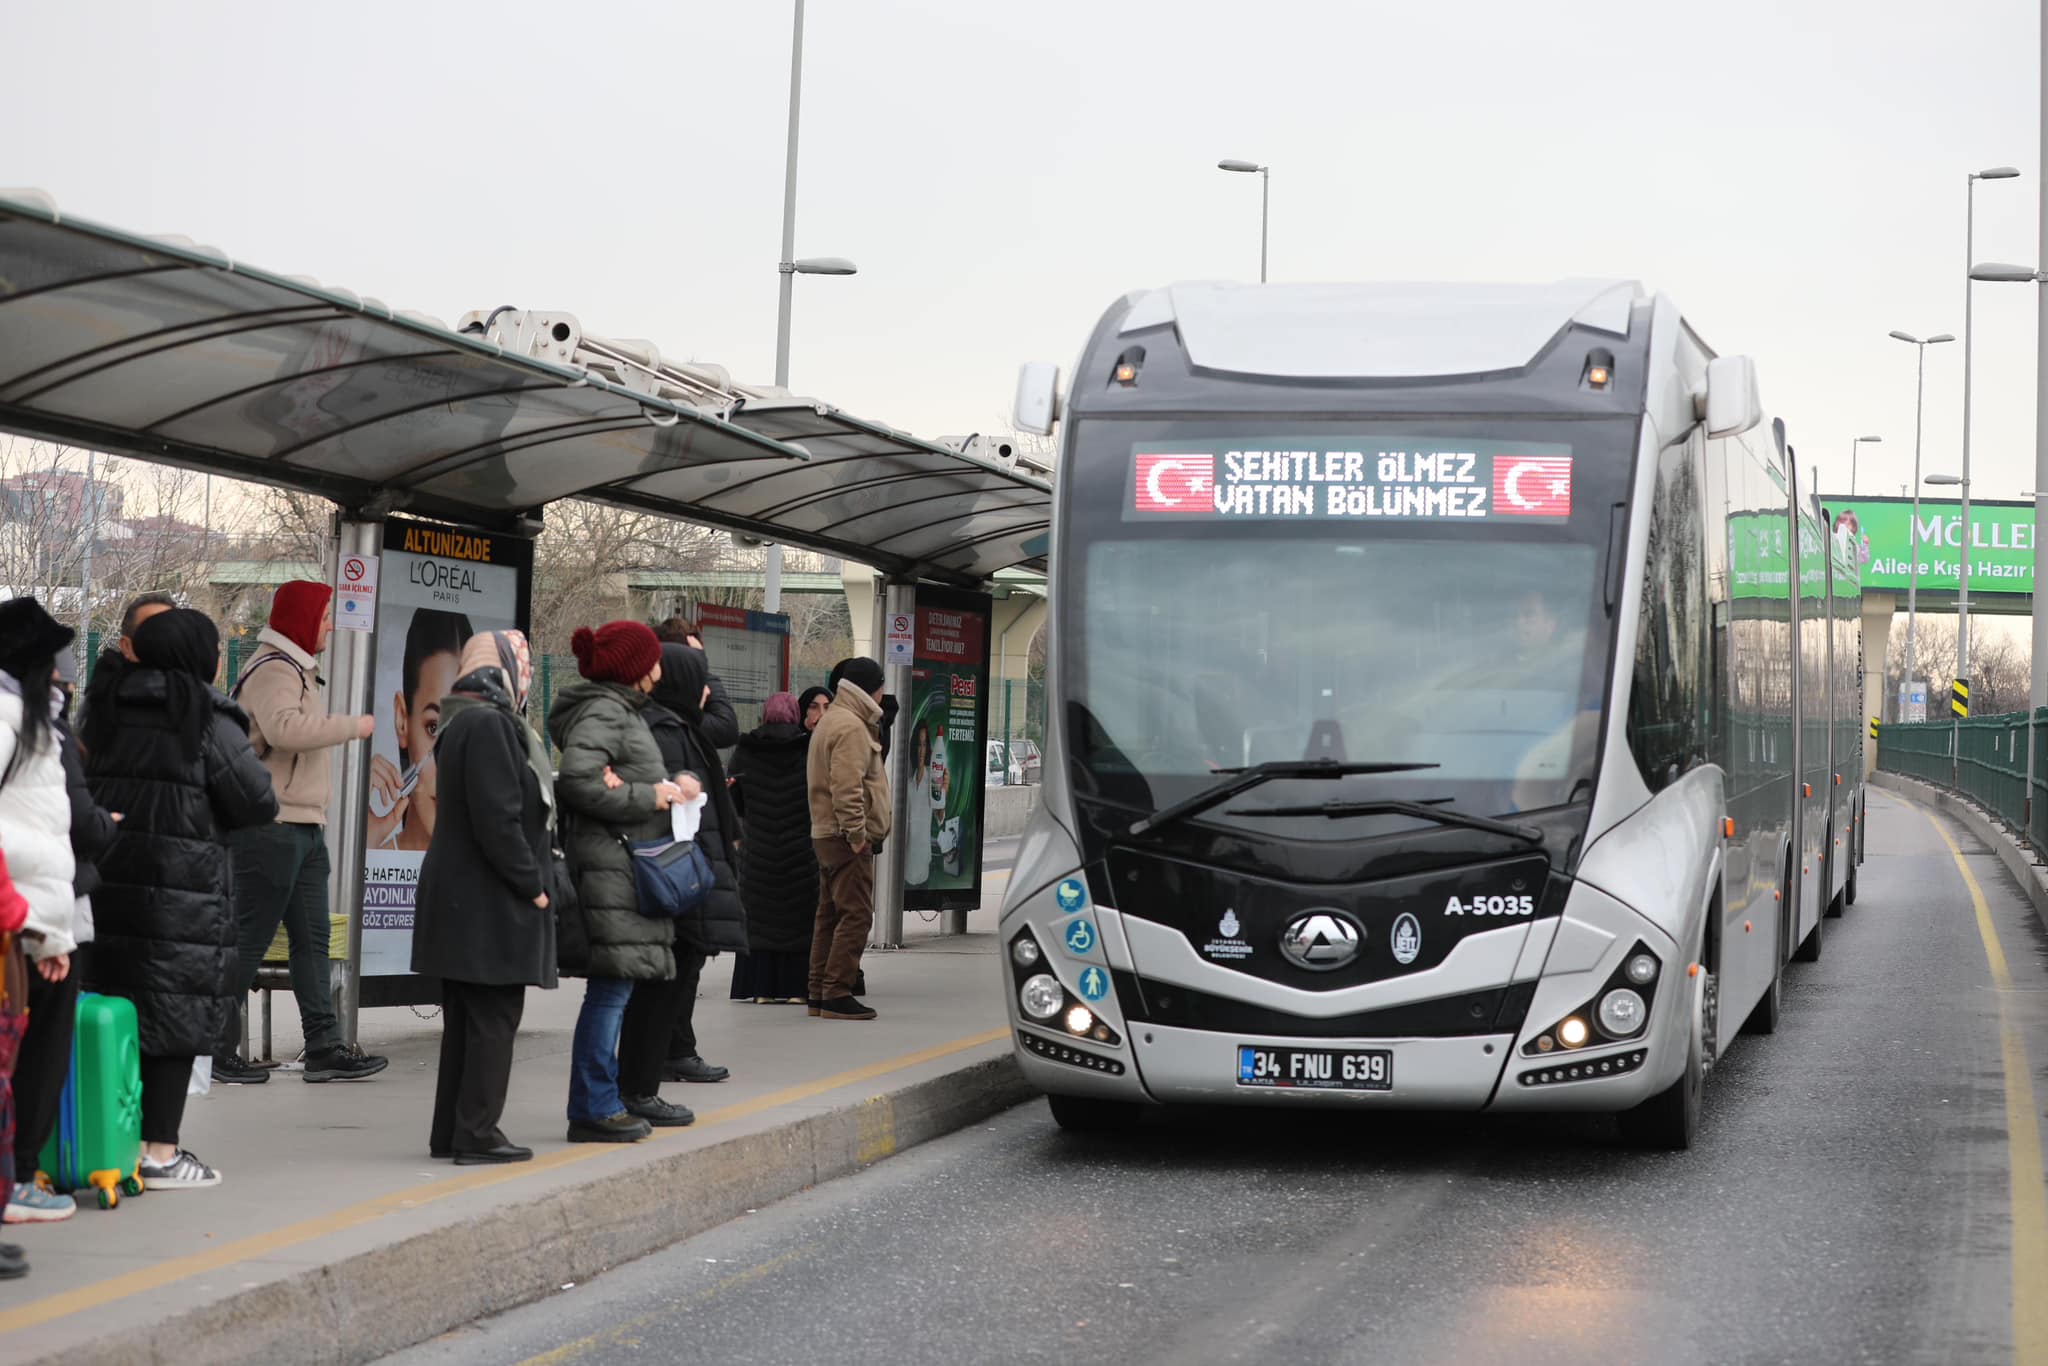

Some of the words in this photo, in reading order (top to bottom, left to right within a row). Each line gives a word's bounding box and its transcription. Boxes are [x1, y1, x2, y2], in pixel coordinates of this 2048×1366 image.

[1224, 451, 1364, 483] ŞEHİTLER
[1378, 452, 1476, 482] ÖLMEZ
[1214, 485, 1314, 514] VATAN
[1327, 485, 1487, 516] BÖLÜNMEZ
[403, 527, 491, 562] ALTUNİZADE
[410, 560, 482, 593] L'ORÉAL
[1978, 561, 2027, 577] Hazır
[433, 591, 460, 604] PARIS
[363, 887, 417, 905] AYDINLIK
[1444, 896, 1534, 915] A-5035
[362, 911, 381, 927] GÖZ
[382, 914, 415, 929] ÇEVRES
[1254, 1052, 1281, 1077] 34
[1290, 1053, 1332, 1079] FNU
[1342, 1055, 1384, 1081] 639
